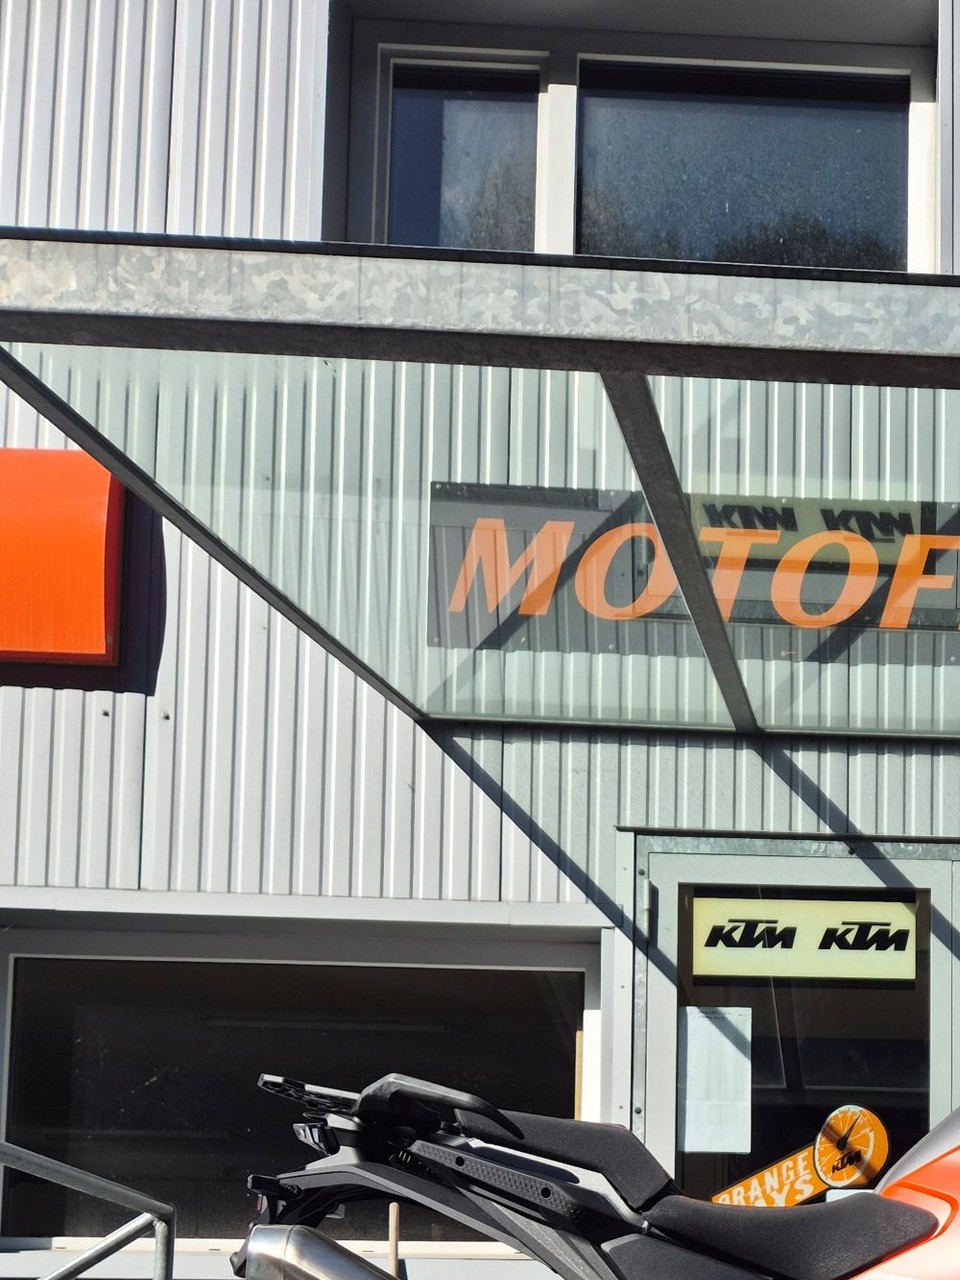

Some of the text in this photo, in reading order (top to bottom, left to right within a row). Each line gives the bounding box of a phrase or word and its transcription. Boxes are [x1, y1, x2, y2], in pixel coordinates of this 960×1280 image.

[704, 919, 910, 951] KTM KTM
[832, 1150, 862, 1174] KTM
